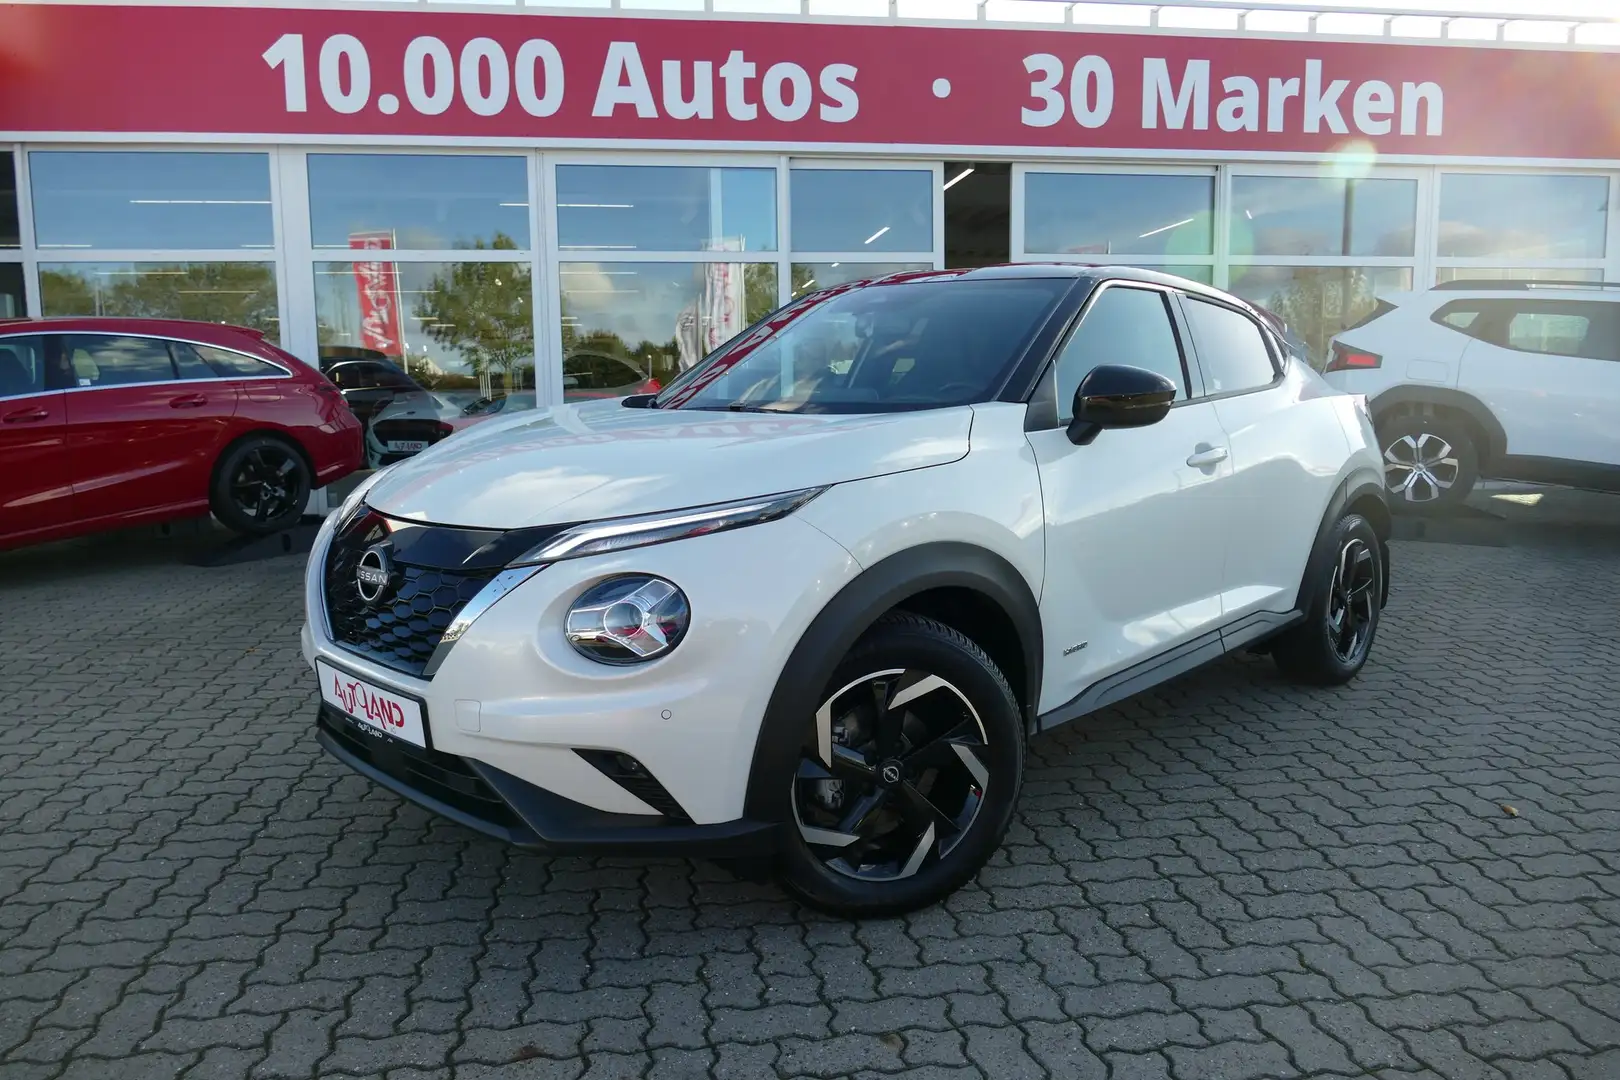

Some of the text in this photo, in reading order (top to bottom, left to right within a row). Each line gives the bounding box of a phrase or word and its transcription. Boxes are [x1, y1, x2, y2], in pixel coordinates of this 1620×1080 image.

[261, 33, 1444, 136] 10.000 Autos 30 Marken
[334, 673, 405, 730] AUTOLAND
